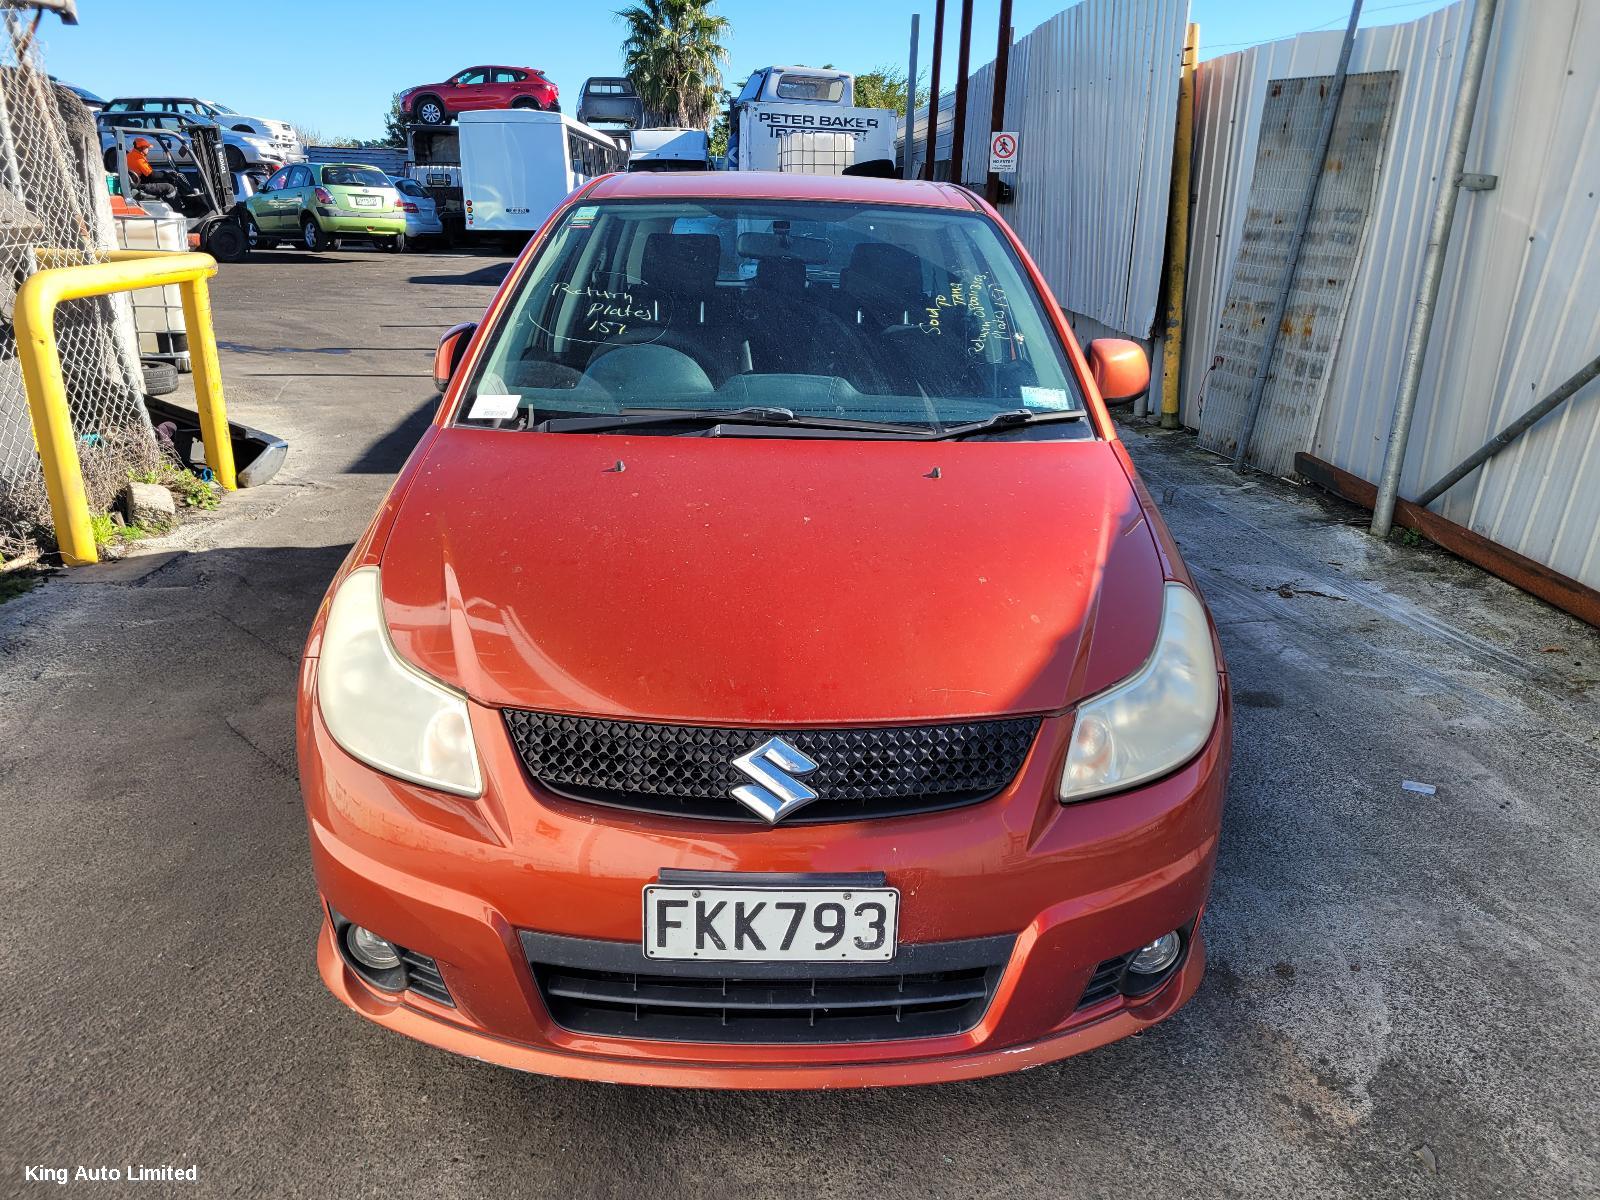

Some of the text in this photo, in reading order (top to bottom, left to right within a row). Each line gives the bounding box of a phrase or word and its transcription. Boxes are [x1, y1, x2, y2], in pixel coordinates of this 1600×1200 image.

[759, 112, 879, 129] PETER BAKER
[218, 151, 227, 174] TOYOTA
[551, 283, 633, 305] Return
[587, 303, 652, 320] Plates
[919, 308, 941, 335] Sold
[656, 899, 887, 951] FKK793
